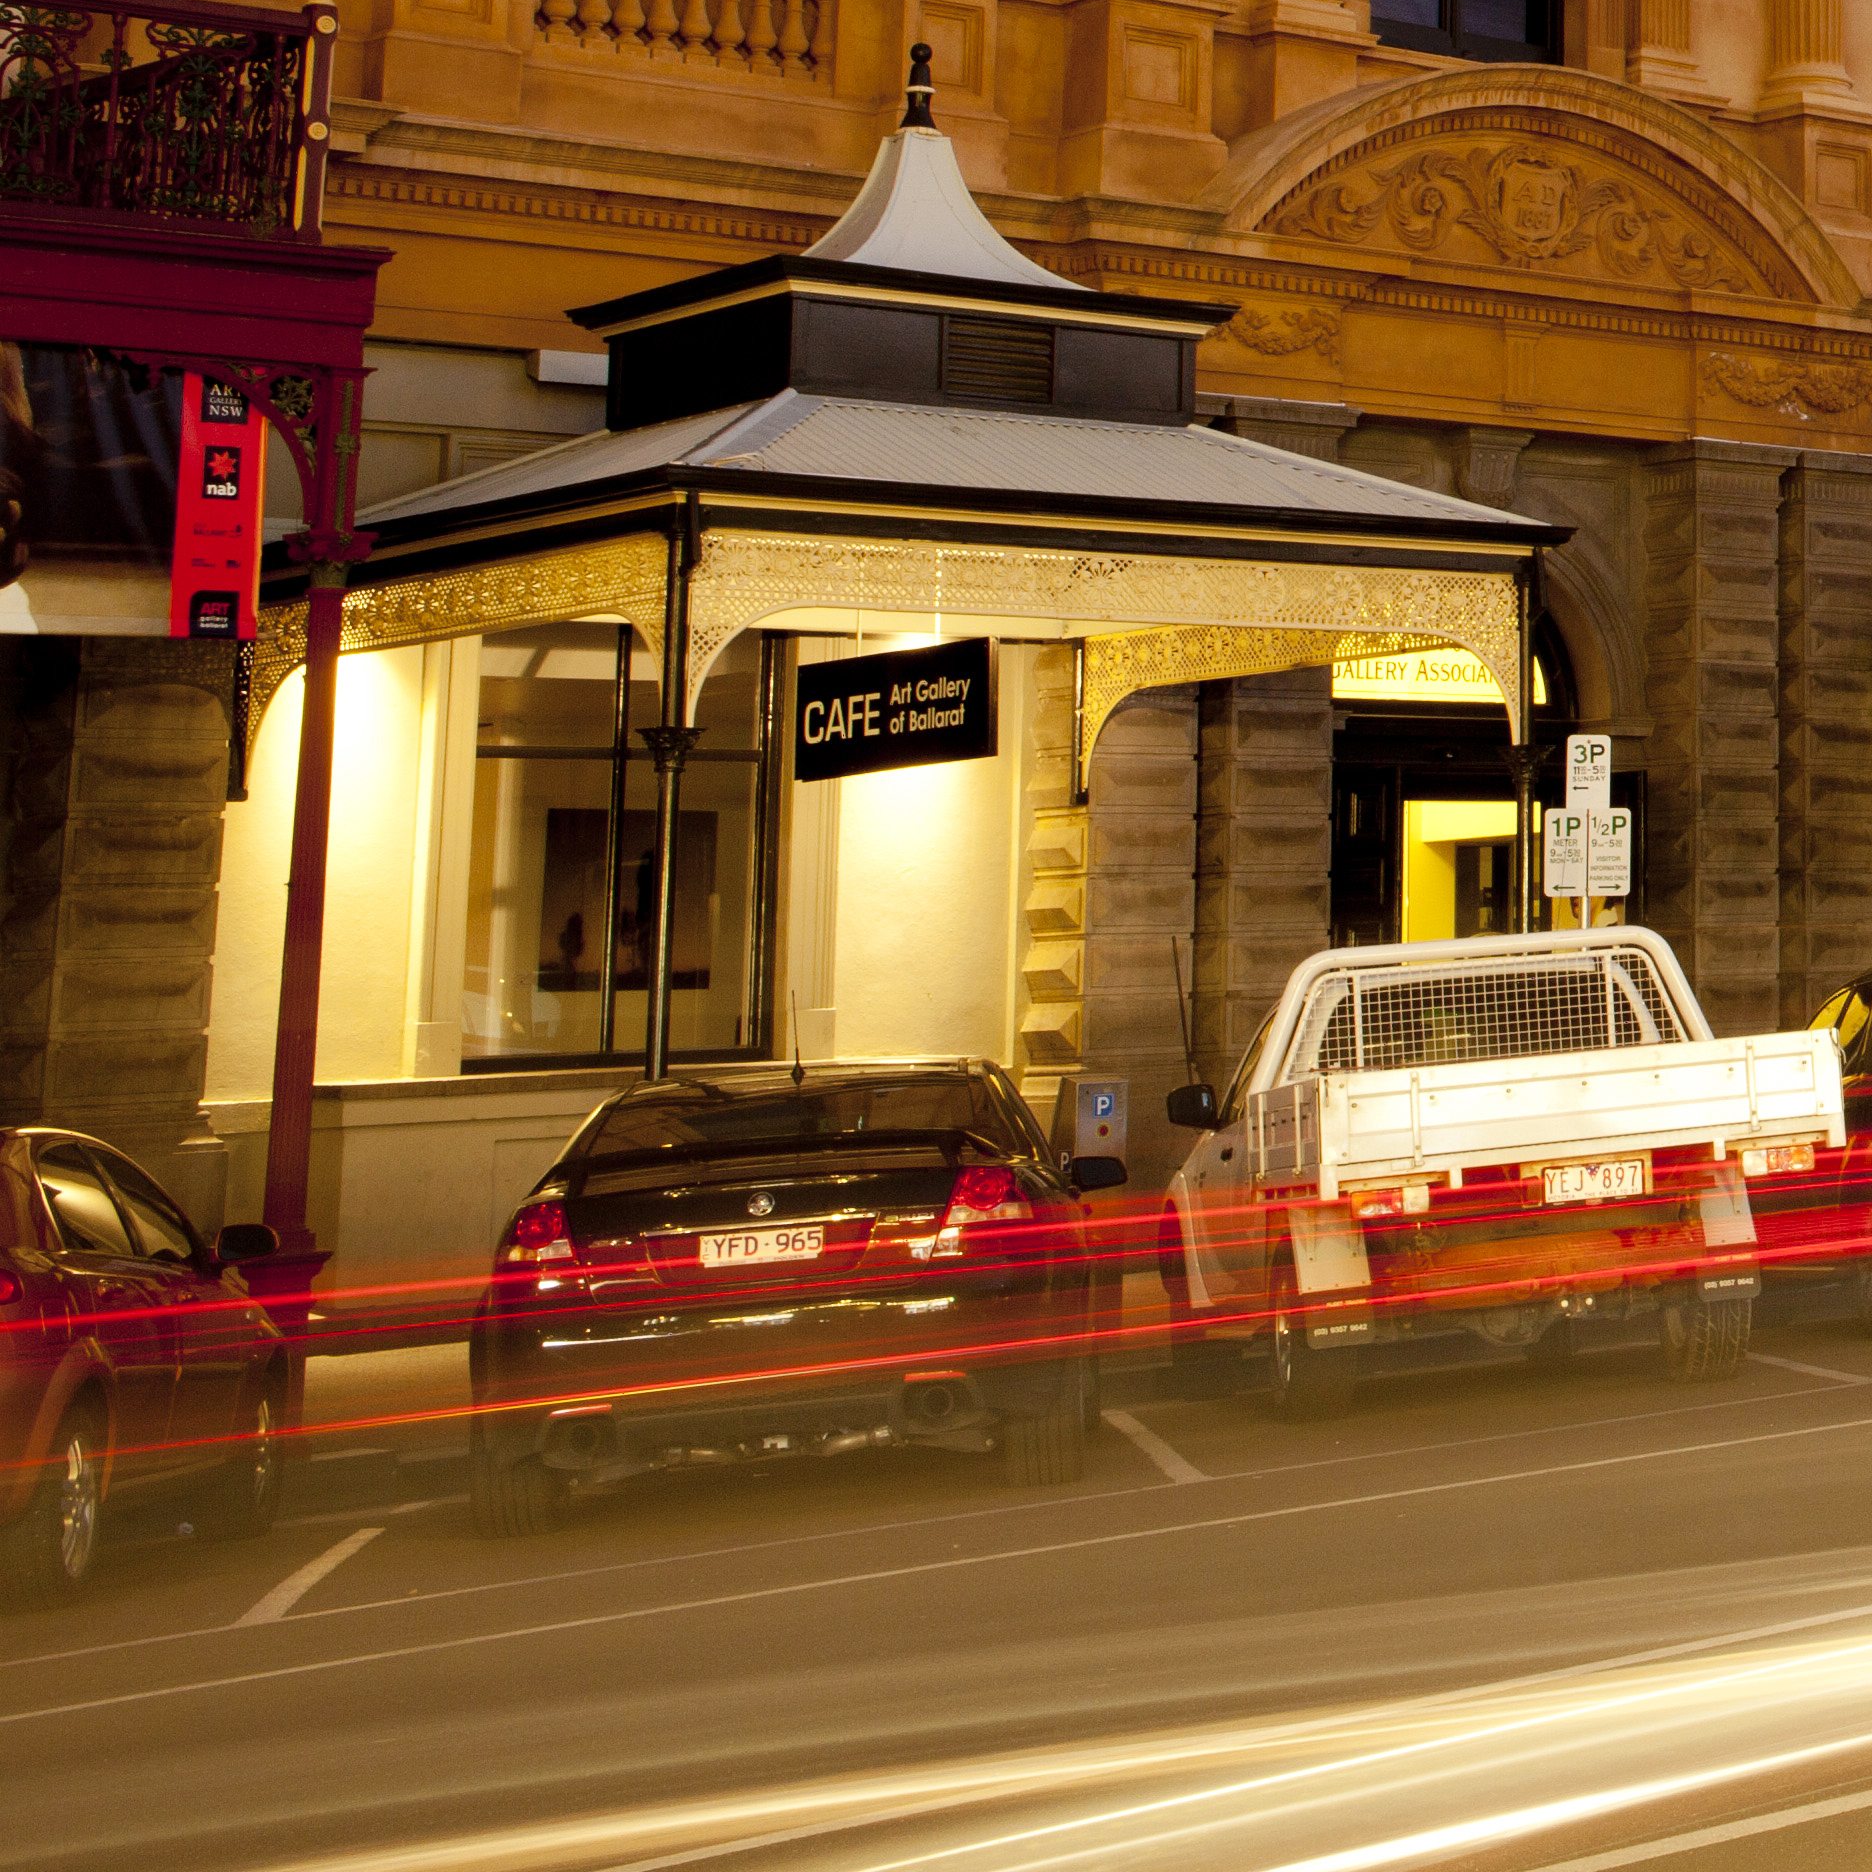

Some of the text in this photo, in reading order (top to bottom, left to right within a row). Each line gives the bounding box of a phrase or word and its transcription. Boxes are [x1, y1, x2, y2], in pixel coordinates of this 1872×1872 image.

[209, 383, 241, 397] AR
[209, 396, 242, 405] GALLER
[209, 404, 243, 417] NSW
[206, 481, 237, 497] nab
[201, 602, 230, 615] ART
[889, 676, 971, 706] Art Gallery
[804, 692, 881, 745] CAFE
[889, 702, 966, 735] of Ballarat
[1573, 743, 1605, 764] 3P
[1551, 816, 1581, 837] 1P
[1591, 815, 1627, 836] 1/2P
[1553, 839, 1578, 847] METER
[1545, 1165, 1638, 1195] YEJ 897
